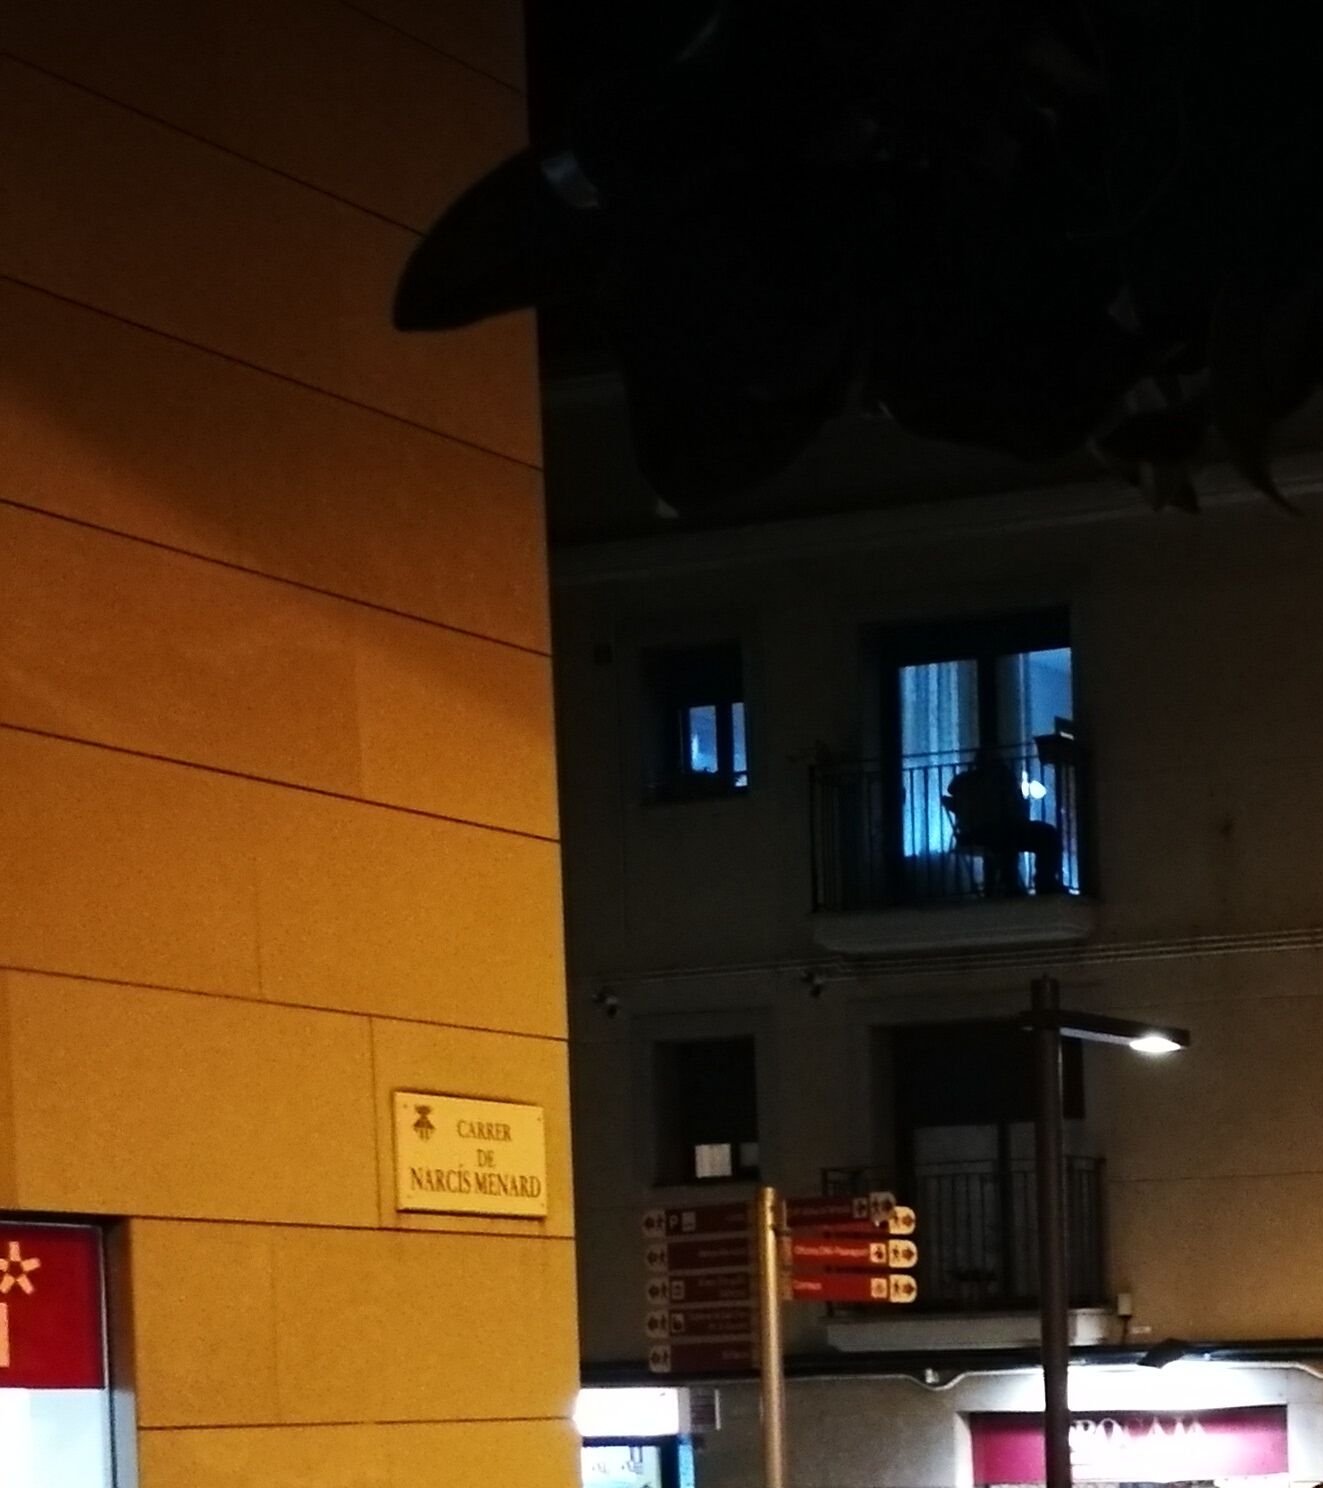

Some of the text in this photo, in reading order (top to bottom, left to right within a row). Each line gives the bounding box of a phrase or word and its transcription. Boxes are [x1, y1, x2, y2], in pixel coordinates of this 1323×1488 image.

[456, 1119, 512, 1142] CARRER
[477, 1149, 496, 1168] DE
[411, 1163, 541, 1199] NARCÍS MENARD
